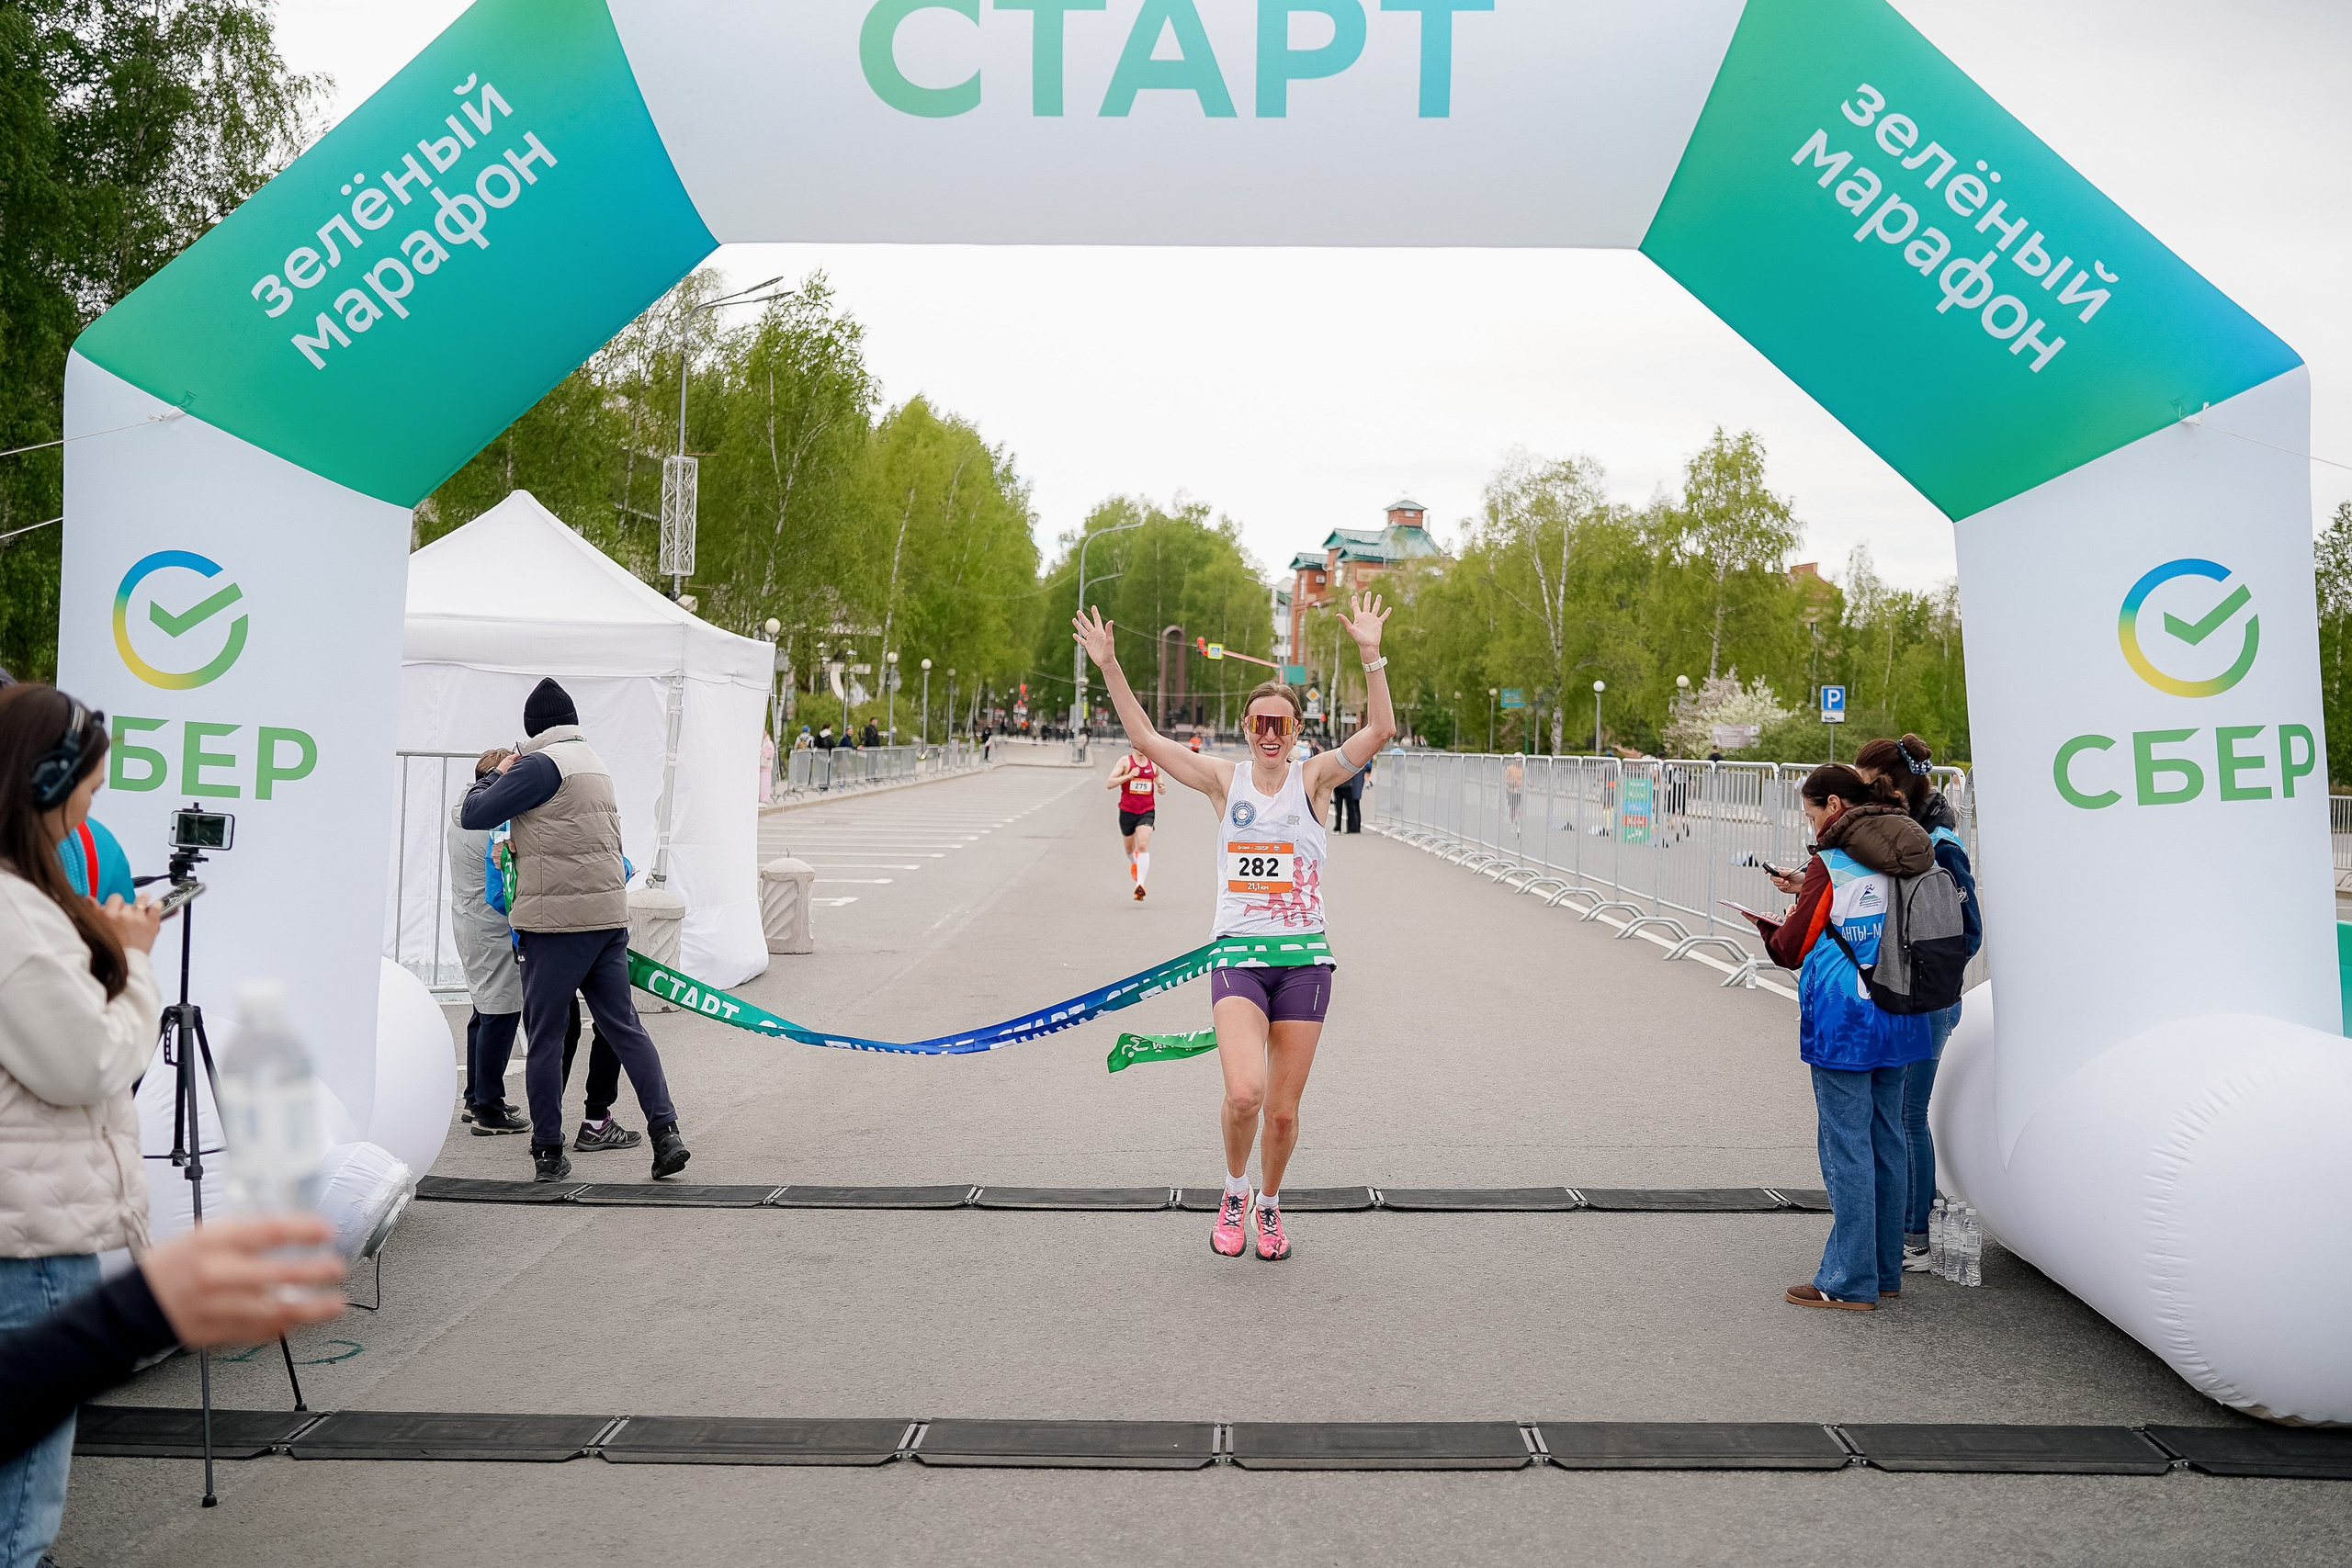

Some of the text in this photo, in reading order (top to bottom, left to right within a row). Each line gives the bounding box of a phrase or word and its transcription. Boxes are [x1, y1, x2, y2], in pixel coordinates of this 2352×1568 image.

[860, 0, 1496, 118] СТАРТ
[251, 73, 514, 319] зелёный
[1840, 83, 2120, 323] зелёный
[290, 131, 558, 370] марафон
[1791, 129, 2066, 373] марафон
[1827, 689, 1841, 709] P
[108, 715, 318, 801] БЕР
[2052, 724, 2316, 810] СБЕР
[1238, 857, 1279, 877] 282
[648, 969, 741, 1019] СТАРТ
